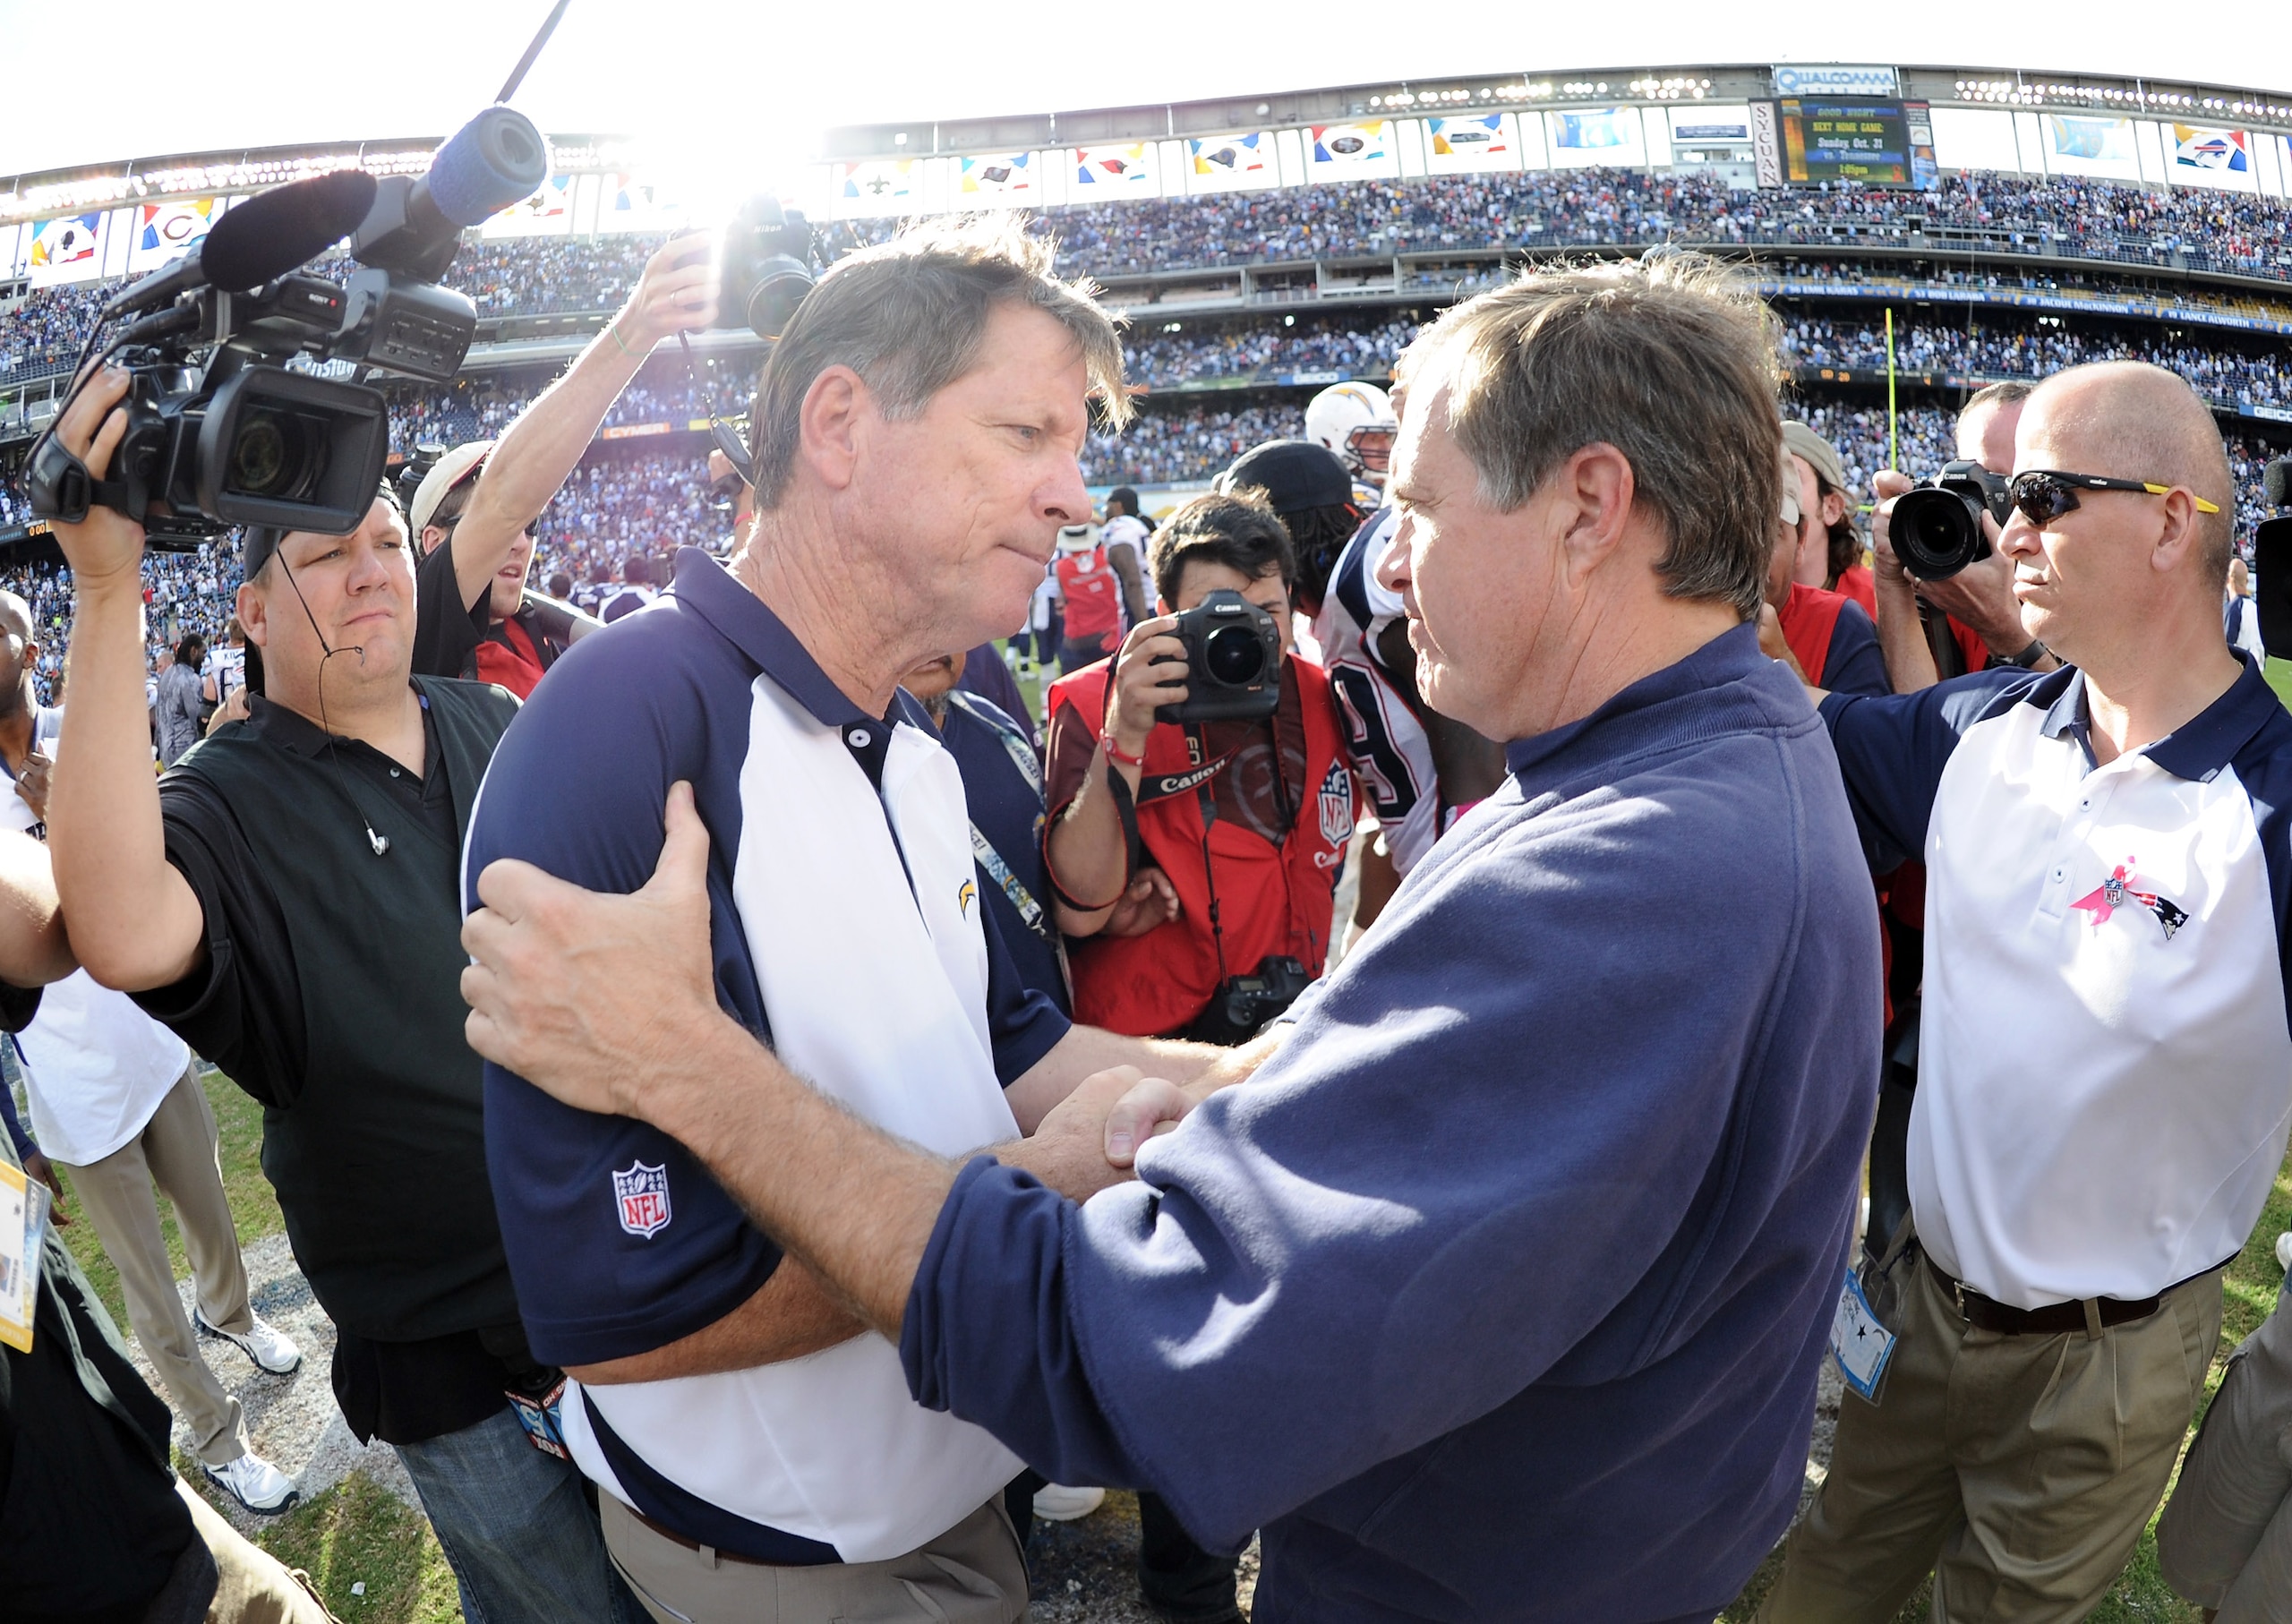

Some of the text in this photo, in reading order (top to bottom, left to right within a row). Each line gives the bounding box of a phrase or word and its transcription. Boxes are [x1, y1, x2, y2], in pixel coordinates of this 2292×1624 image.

[1778, 69, 1895, 90] QUALCOMM
[1813, 122, 1833, 132] NEXT
[1835, 122, 1858, 132] HOME
[1757, 106, 1778, 183] SYCUAN
[1817, 137, 1850, 150] Sunday,
[1852, 137, 1869, 149] Oct.
[754, 224, 782, 234] Nikon
[309, 293, 329, 304] SONY
[1928, 290, 1947, 300] BOB
[2179, 312, 2207, 323] LANCE
[2208, 313, 2250, 329] ALWORTH
[1292, 372, 1340, 385] GEICO
[1944, 472, 1967, 481] Canon
[1215, 604, 1242, 612] Canon
[1160, 759, 1226, 793] Canon
[1325, 795, 1349, 834] NFL
[2106, 890, 2120, 902] NFL
[624, 1194, 665, 1227] NFL
[531, 1434, 565, 1459] FOX
